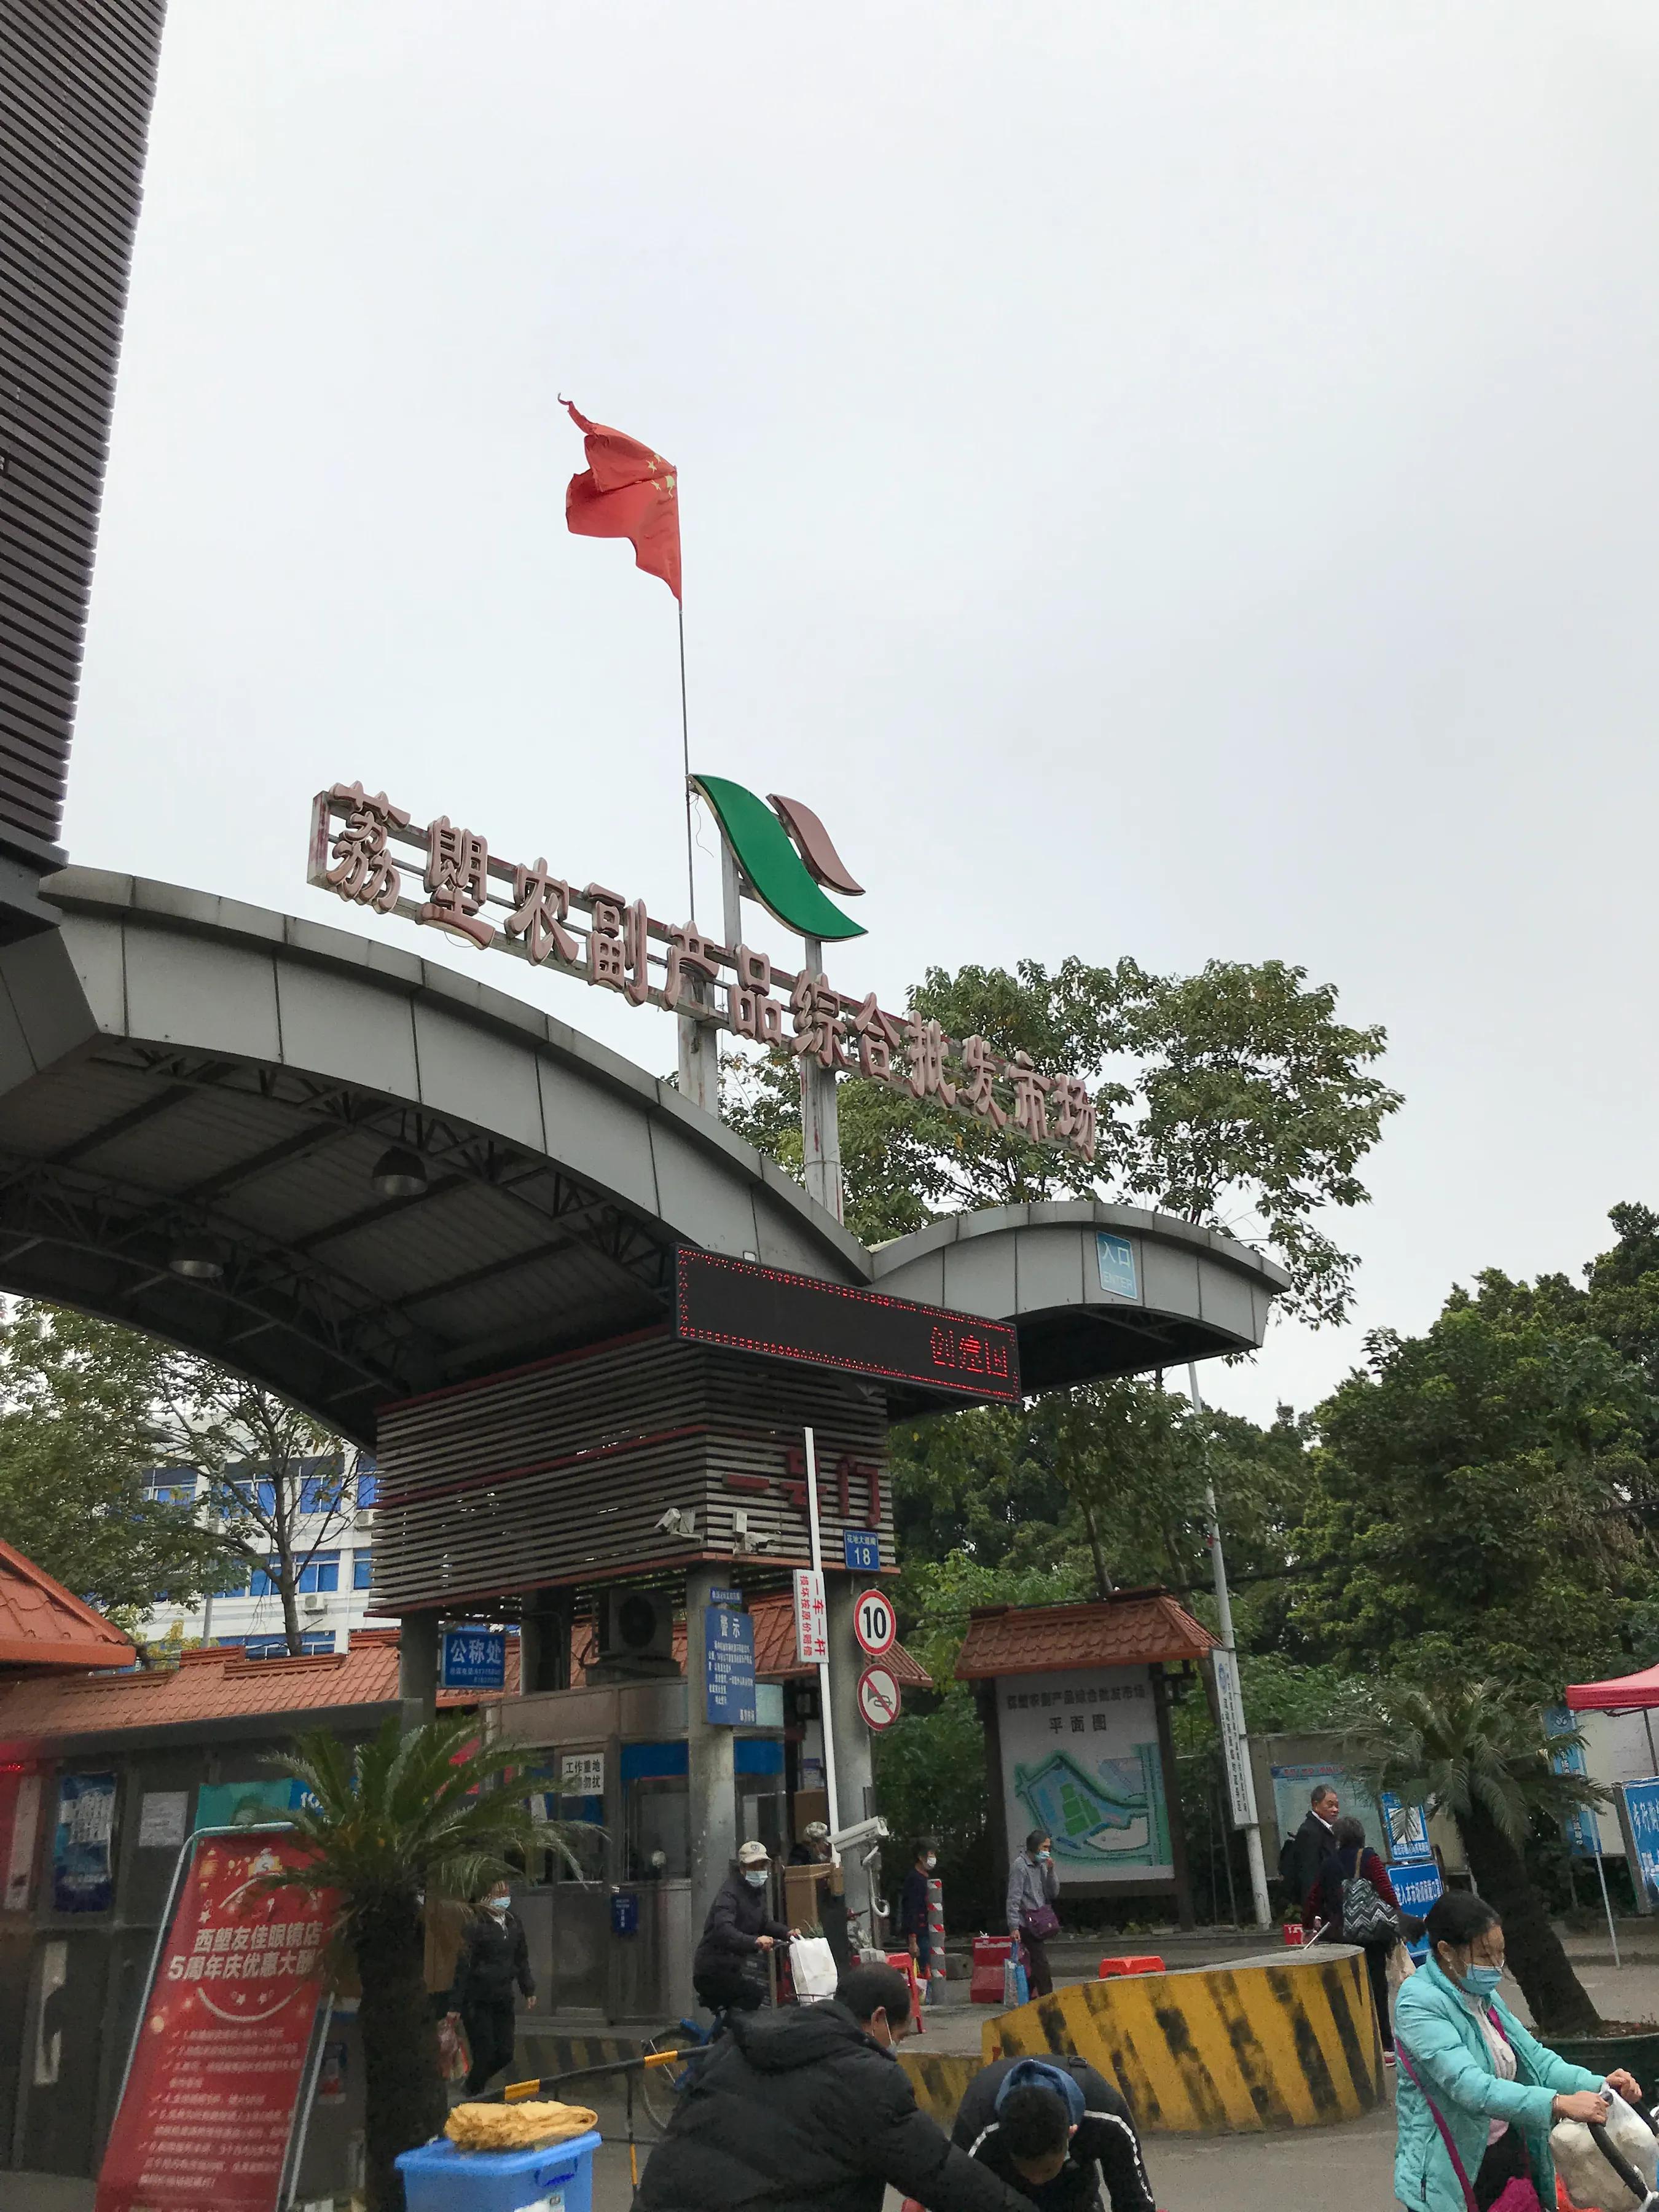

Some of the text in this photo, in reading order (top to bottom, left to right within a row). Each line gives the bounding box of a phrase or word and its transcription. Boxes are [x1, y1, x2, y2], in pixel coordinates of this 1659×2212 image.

[327, 780, 1097, 1163] 荔塱农副产品综合批发市场
[1102, 1241, 1131, 1268] 入口
[1102, 1271, 1133, 1289] ENTER
[722, 1446, 881, 1528] 一号门
[854, 1547, 871, 1566] 18
[812, 1578, 826, 1656] 一车一杆
[863, 1606, 887, 1639] 10
[566, 1759, 601, 1774] 工作重地
[193, 1921, 323, 1953] 西塱友佳眼镜店
[168, 1948, 324, 1980] 5周年庆优惠大酬
